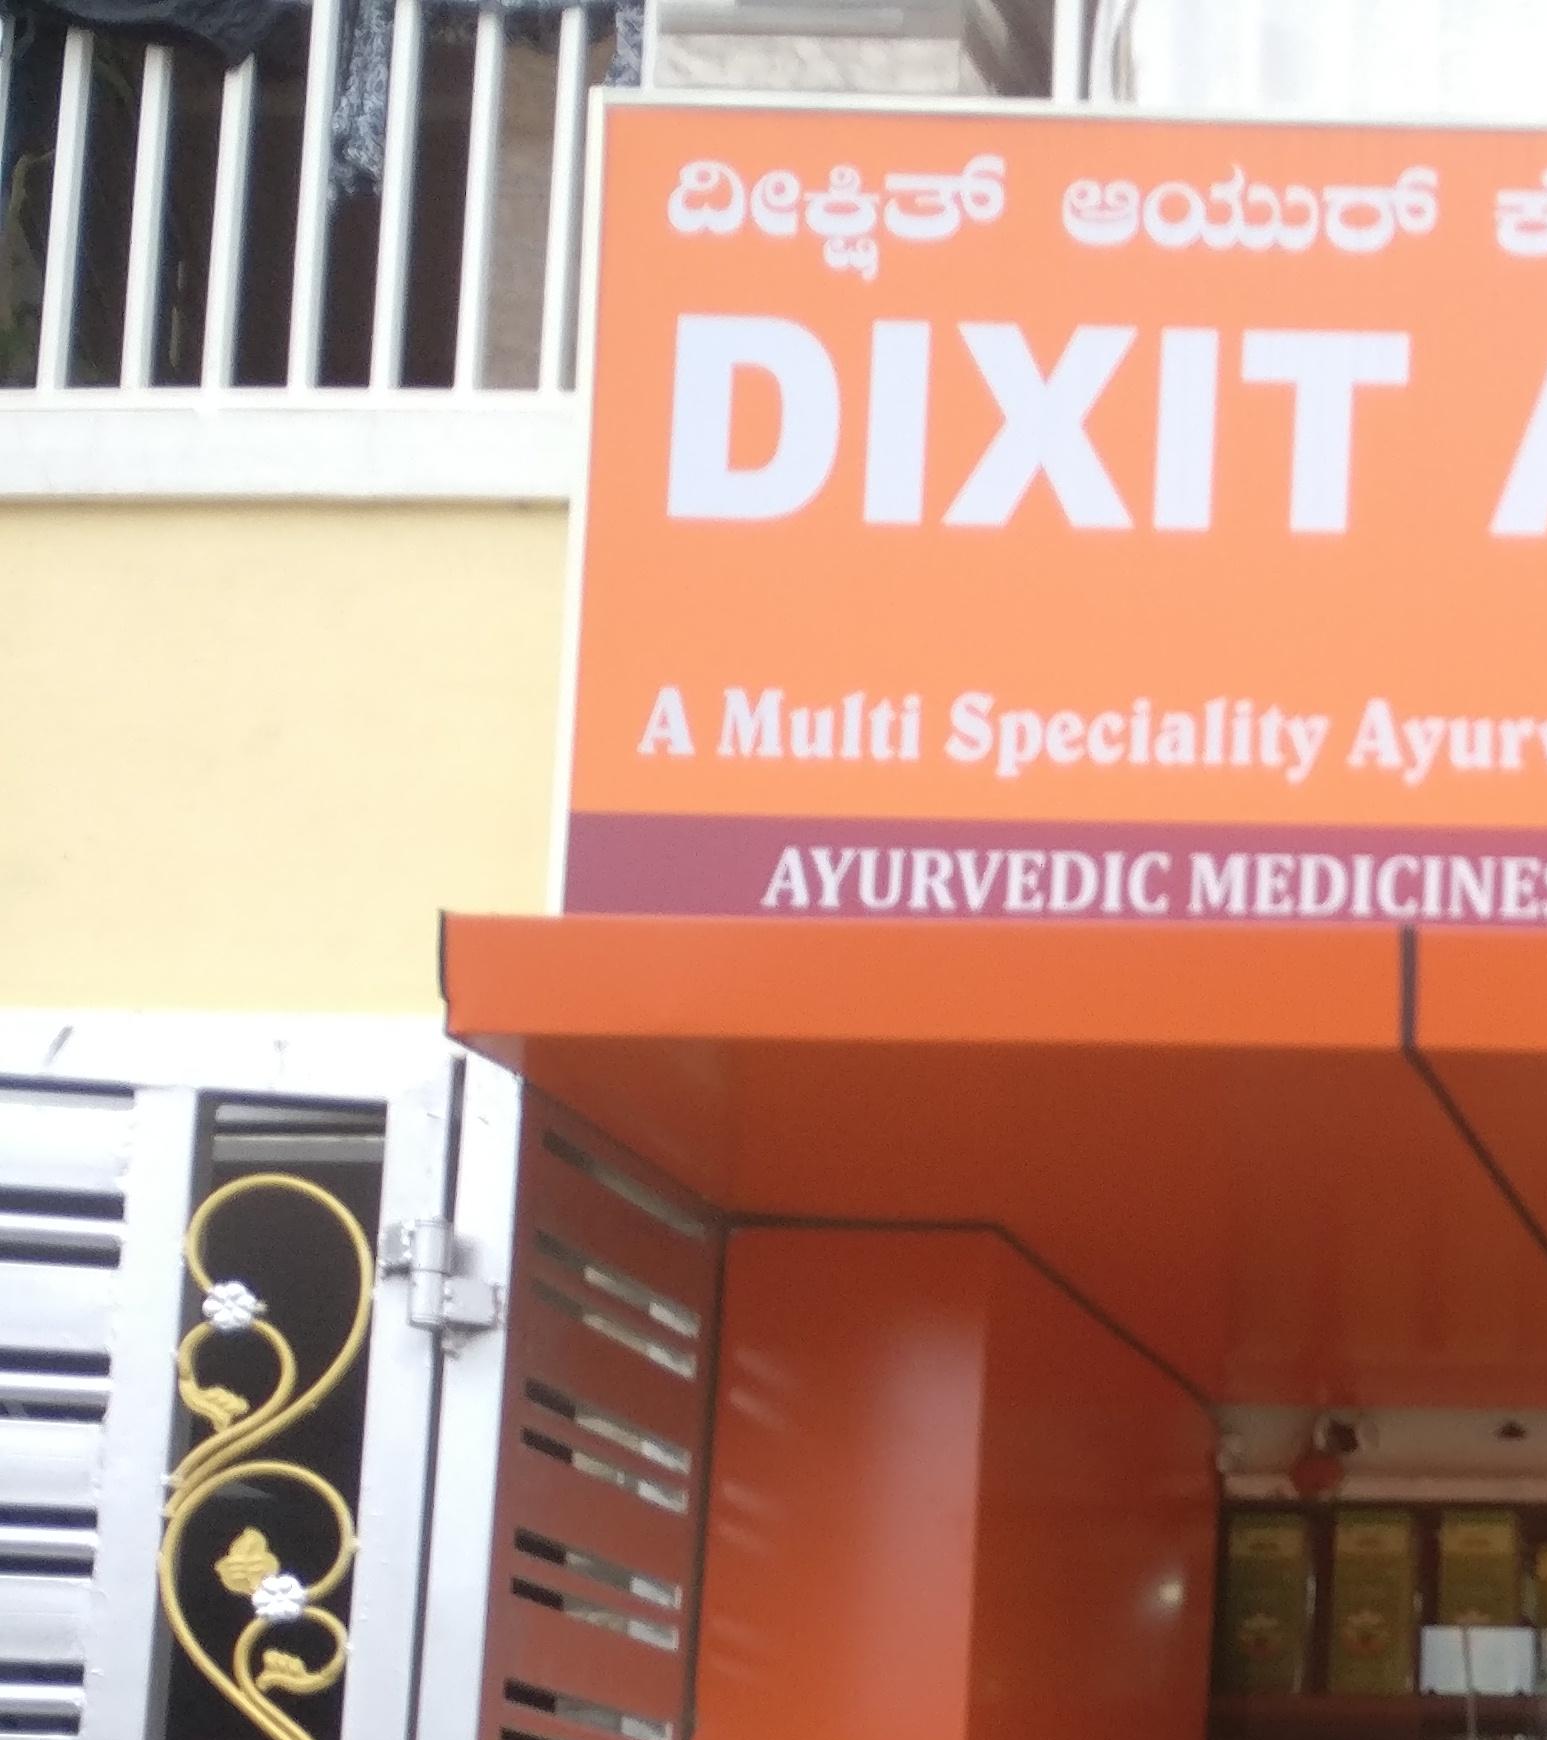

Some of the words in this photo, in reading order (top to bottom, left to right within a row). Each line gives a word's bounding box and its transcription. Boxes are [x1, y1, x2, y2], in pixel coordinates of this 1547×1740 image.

[668, 154, 1005, 281] ದೀಕ್ಷಿತ್
[1063, 166, 1438, 253] ಆಯುರ್
[667, 314, 1411, 534] DIXIT
[638, 686, 694, 756] A
[718, 688, 920, 761] Multi
[945, 692, 1328, 783] Speciality
[763, 848, 1169, 913] AYURVEDIC
